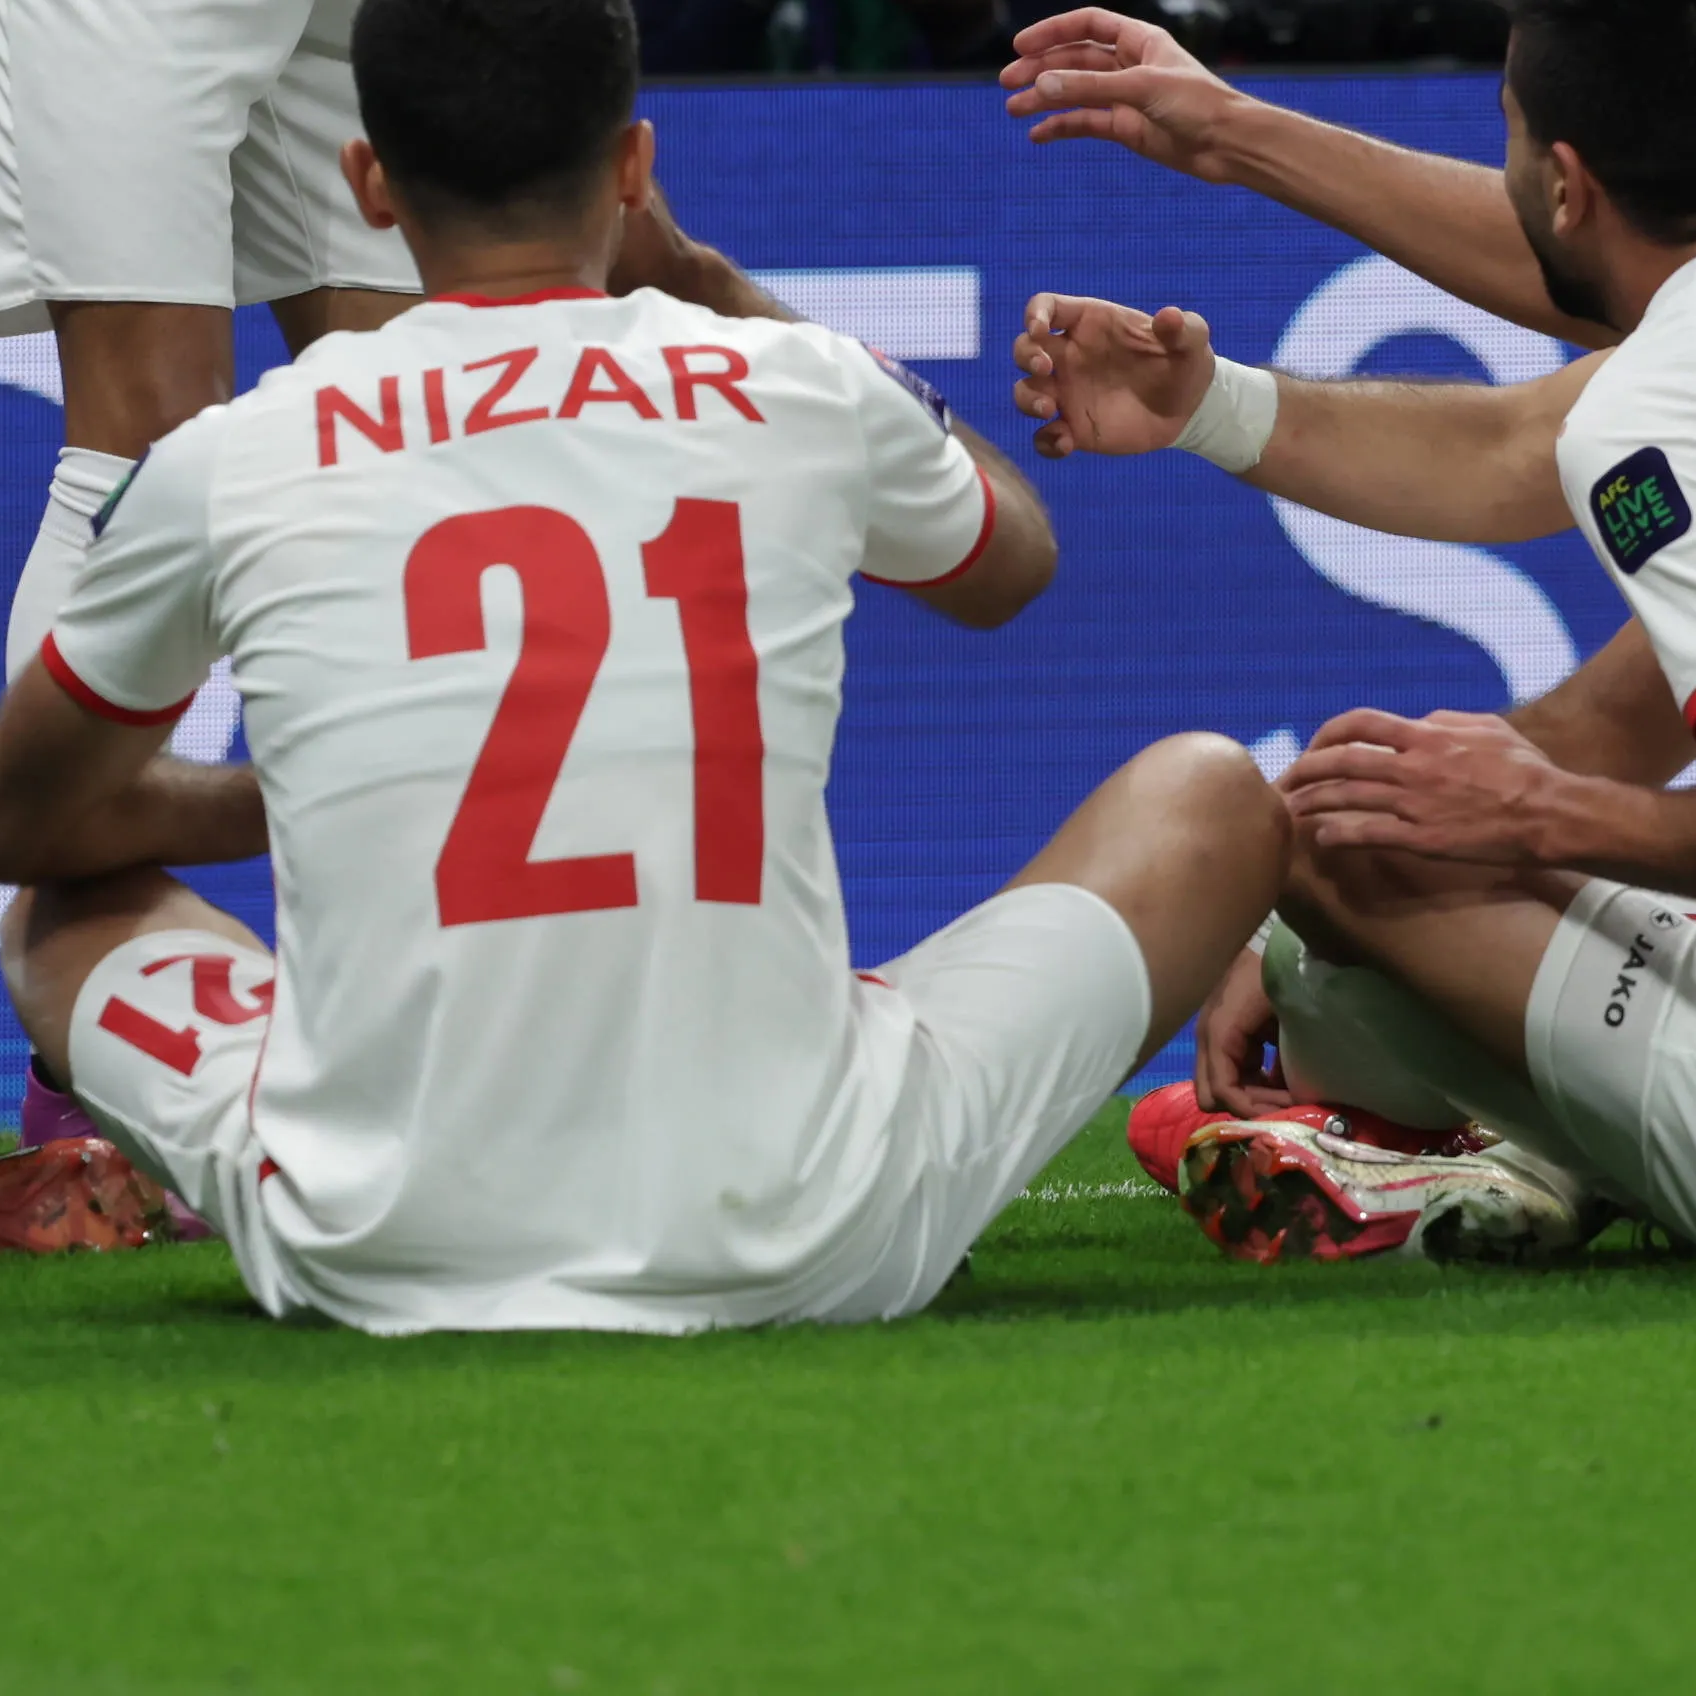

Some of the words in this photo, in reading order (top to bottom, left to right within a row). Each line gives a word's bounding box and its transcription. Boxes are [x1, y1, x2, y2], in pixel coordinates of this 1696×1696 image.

[315, 345, 766, 467] NIZAR
[1599, 475, 1632, 511] AFC
[1604, 475, 1664, 536] LIVE
[403, 497, 765, 927] 21
[98, 953, 276, 1078] 21
[1604, 934, 1654, 1028] JAKO
